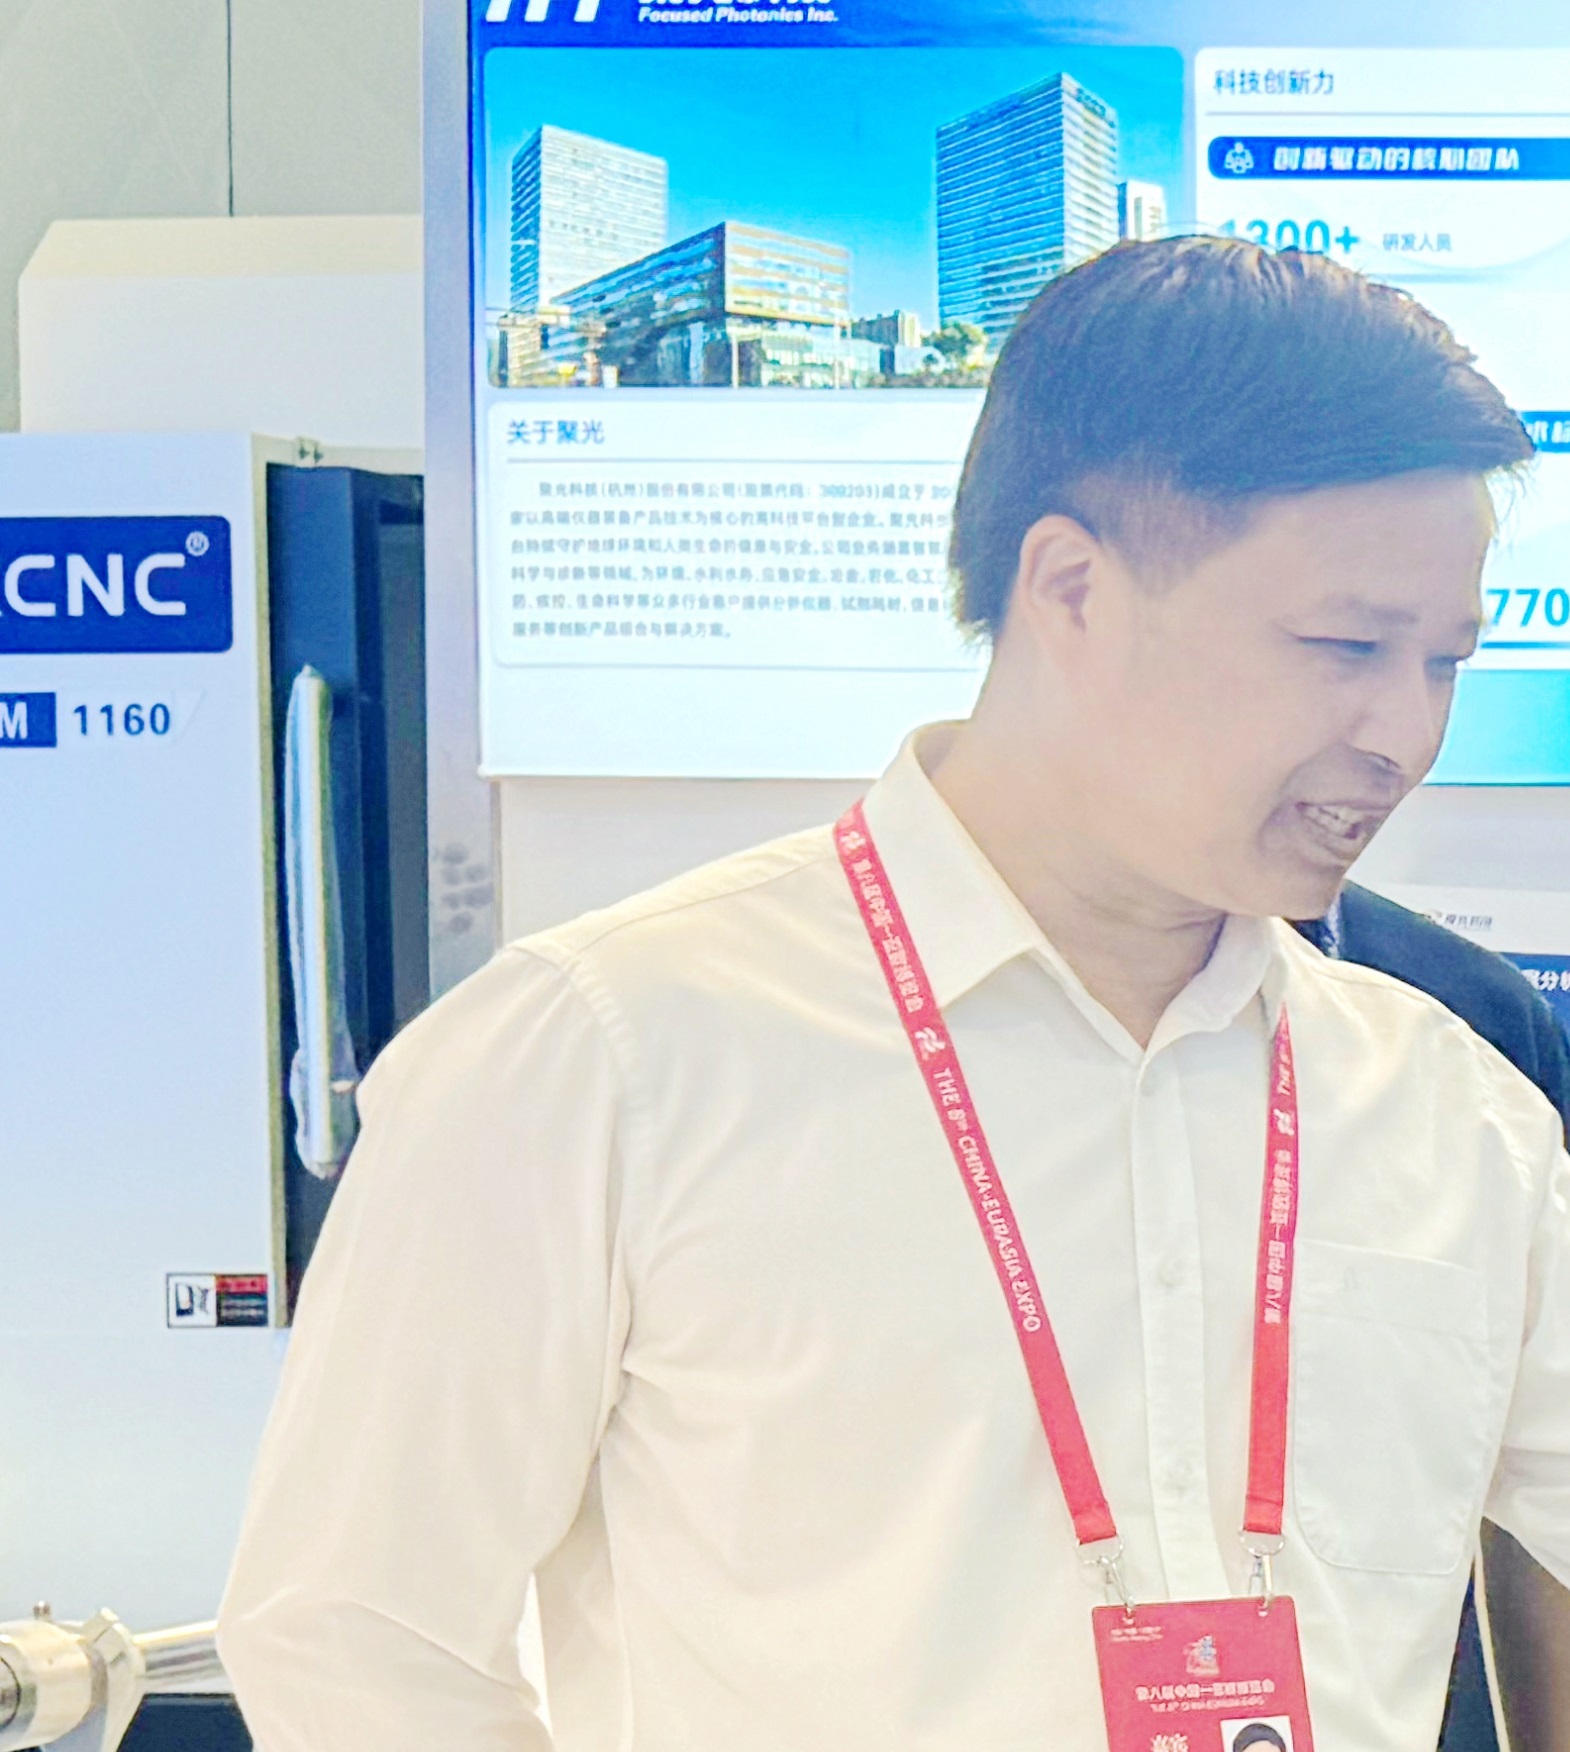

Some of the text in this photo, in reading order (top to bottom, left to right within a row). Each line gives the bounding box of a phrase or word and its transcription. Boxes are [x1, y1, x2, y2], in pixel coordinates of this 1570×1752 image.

[1213, 69, 1334, 95] 科技创新力
[1382, 232, 1452, 252] 研发人员
[506, 420, 605, 445] 关于聚光
[73, 703, 170, 737] 1160
[932, 1067, 962, 1107] THE
